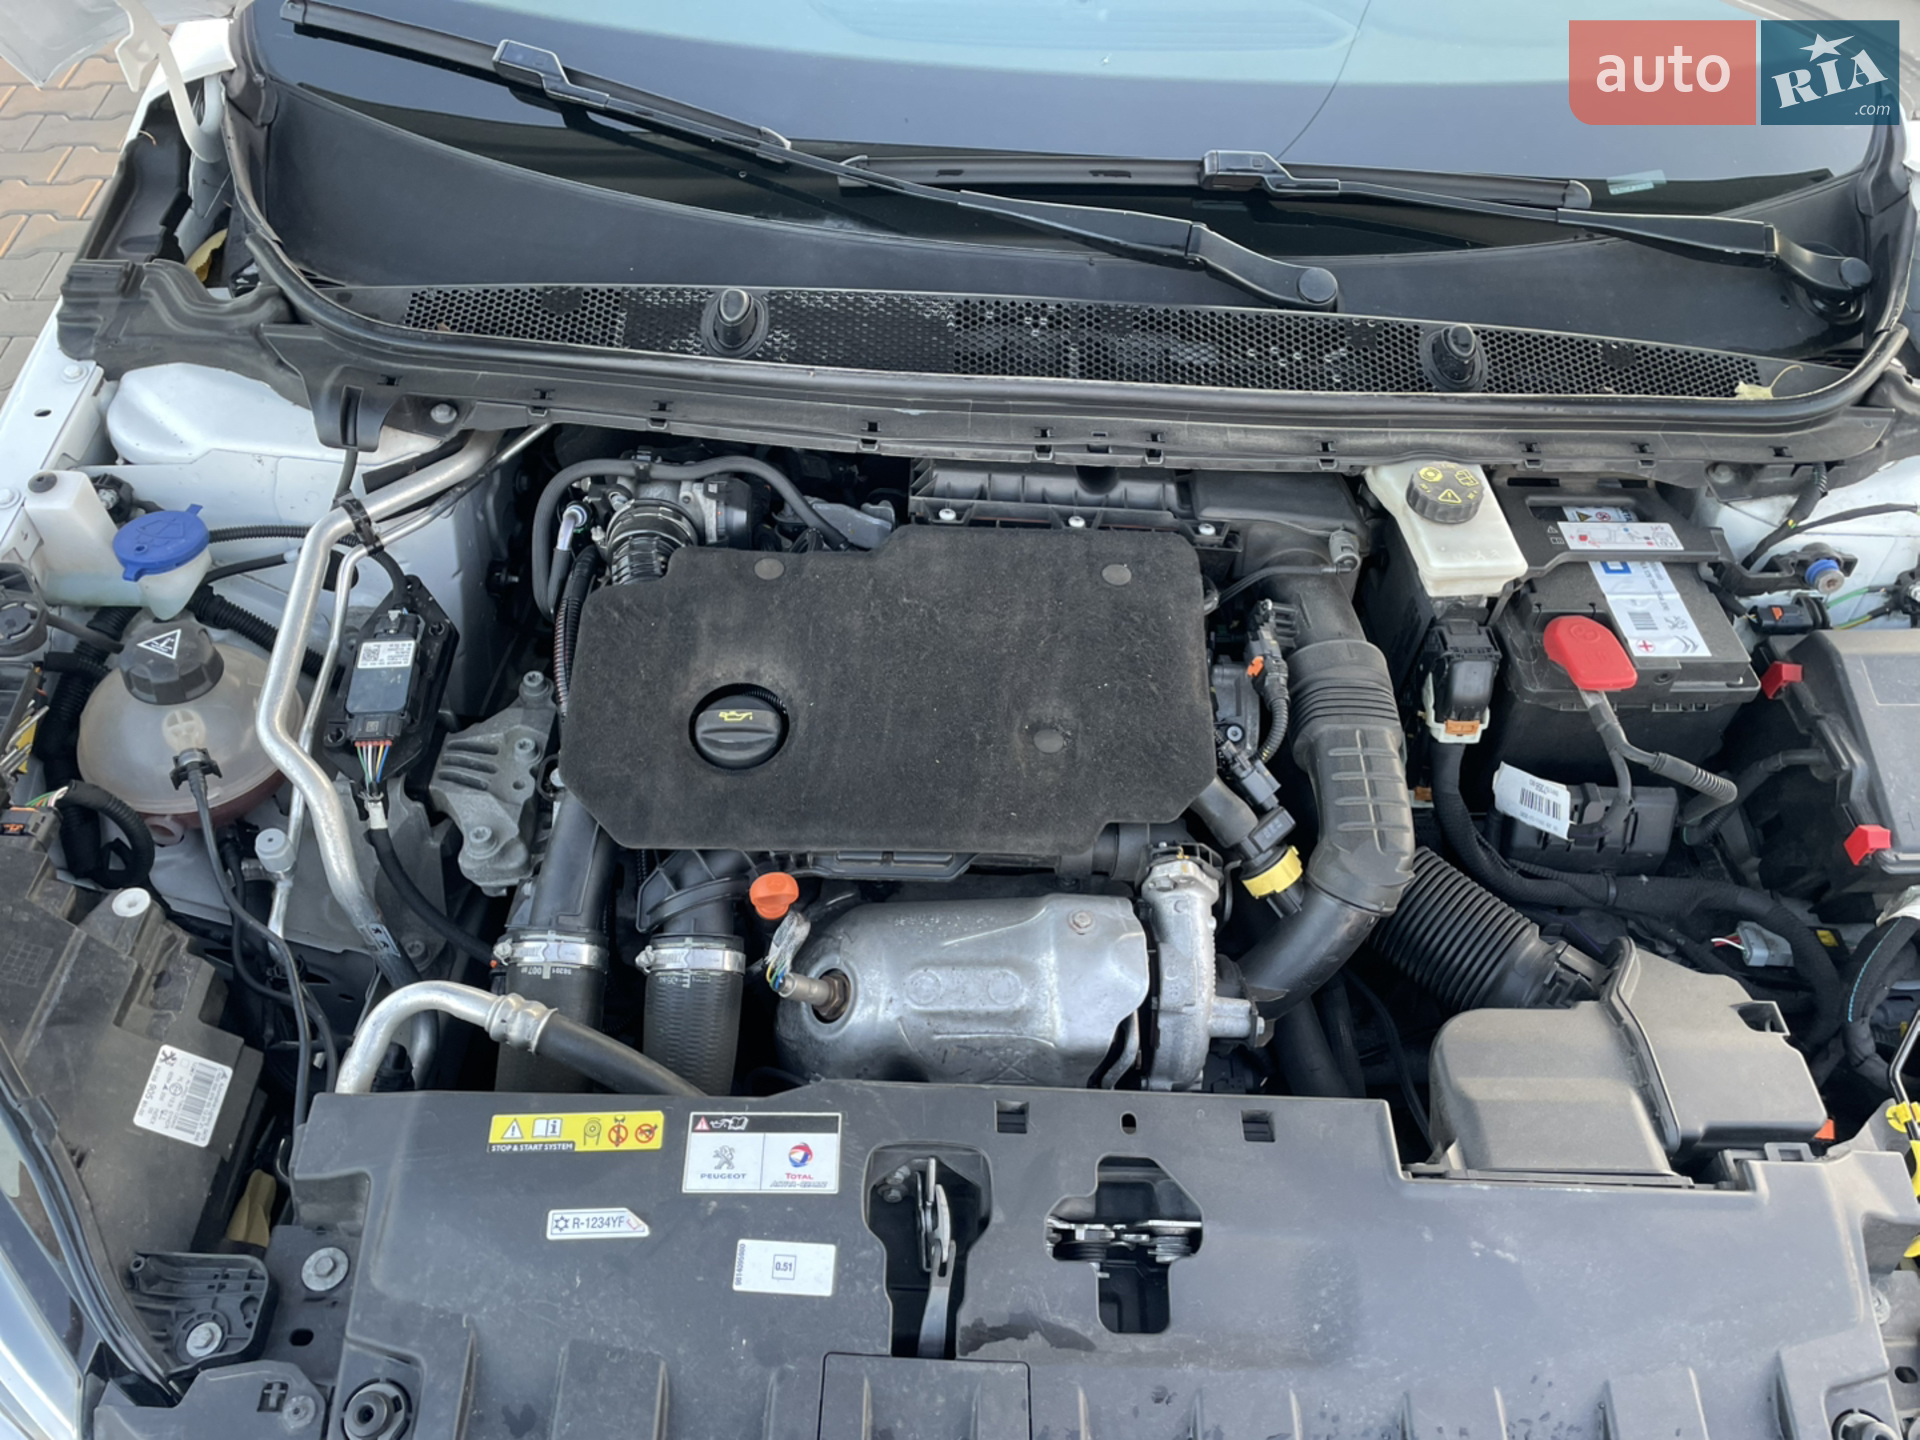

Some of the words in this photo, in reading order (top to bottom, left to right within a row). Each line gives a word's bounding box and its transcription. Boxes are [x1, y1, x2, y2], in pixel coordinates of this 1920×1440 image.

[491, 1144, 512, 1152] STOP
[519, 1143, 543, 1152] START
[544, 1142, 573, 1151] SYSTEM
[785, 1172, 814, 1180] TOTAL
[572, 1215, 626, 1229] R-1234YF
[775, 1262, 793, 1272] 0.51
